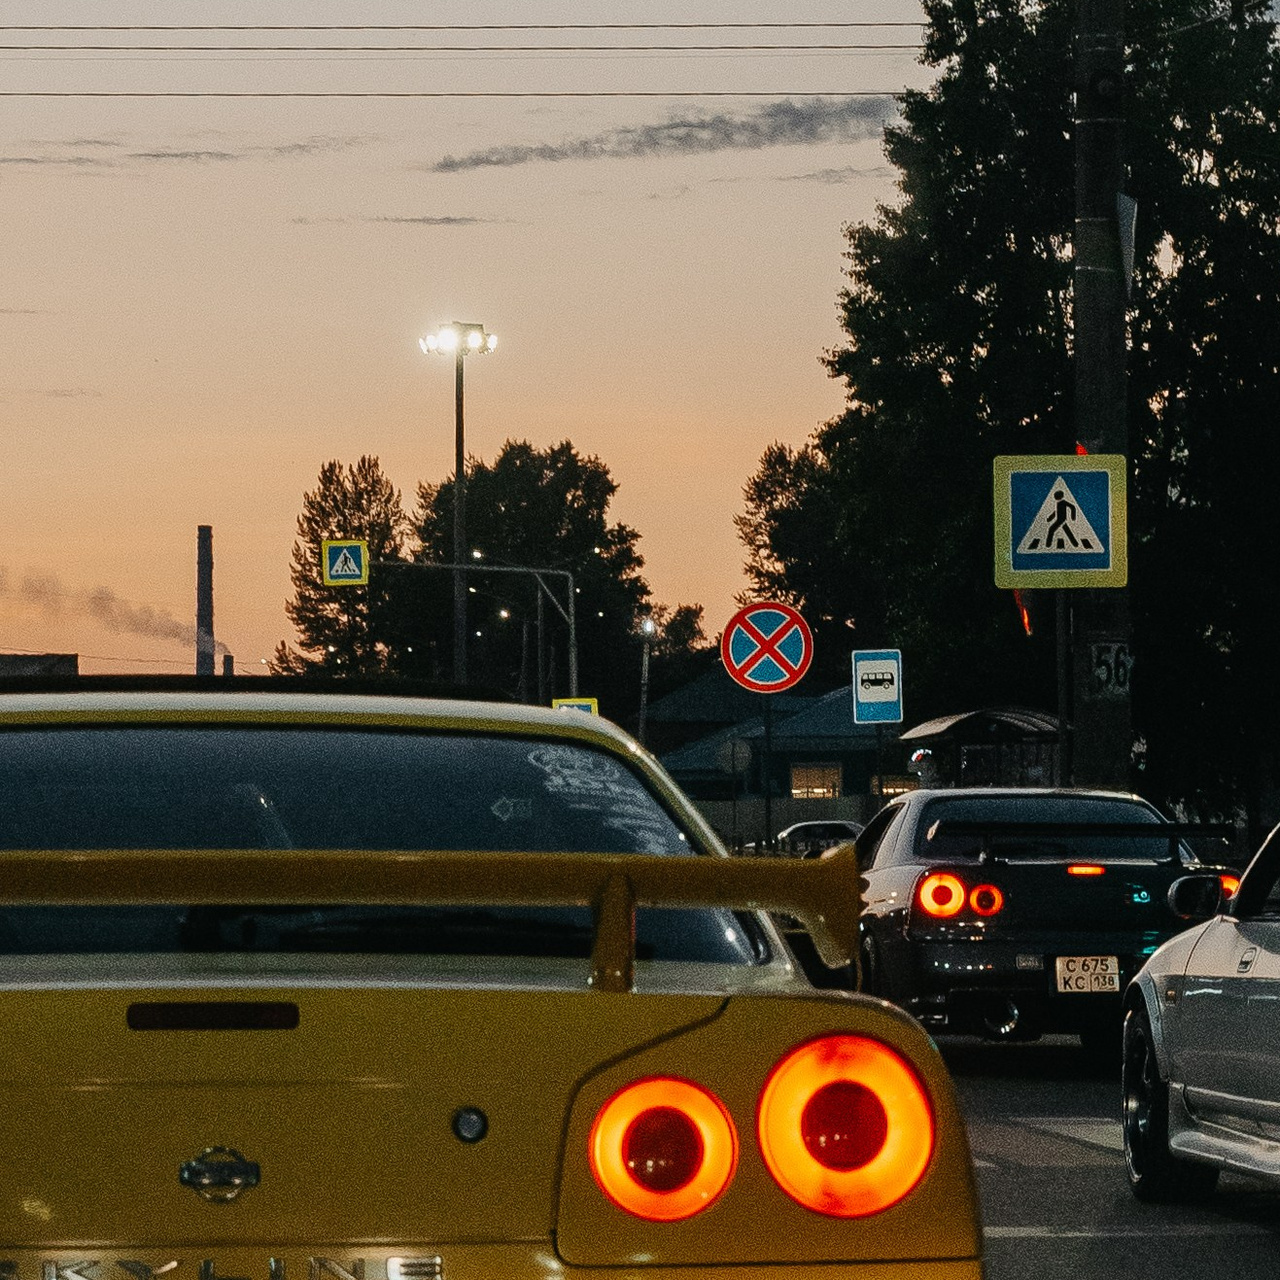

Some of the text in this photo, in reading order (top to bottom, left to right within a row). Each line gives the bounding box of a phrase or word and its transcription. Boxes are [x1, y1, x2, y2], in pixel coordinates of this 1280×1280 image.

[1066, 959, 1109, 972] С 675
[1063, 975, 1115, 990] КС 138
